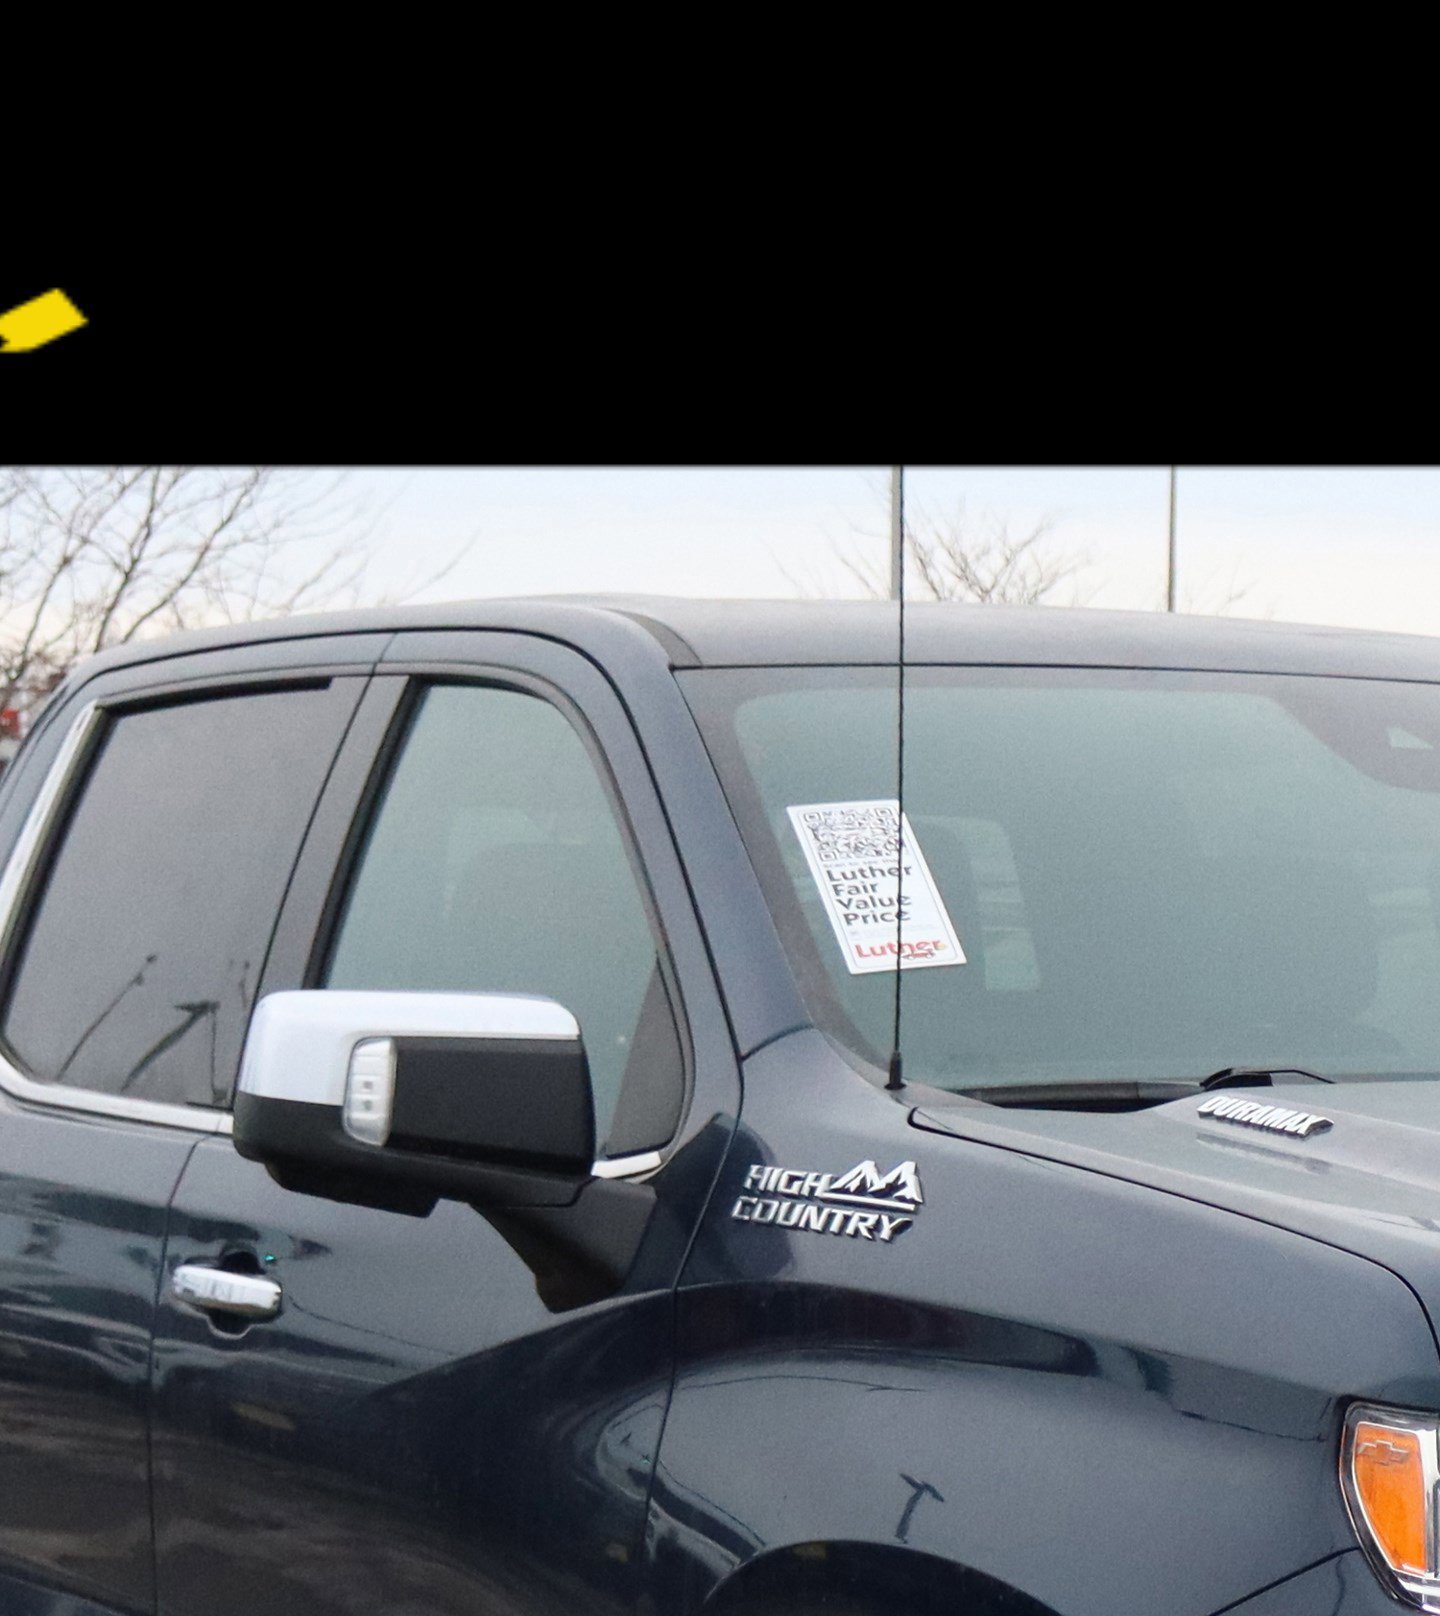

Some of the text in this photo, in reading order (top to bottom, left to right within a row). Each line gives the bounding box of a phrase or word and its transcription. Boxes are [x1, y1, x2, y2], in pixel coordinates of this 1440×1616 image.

[826, 865, 912, 882] Luther
[832, 881, 879, 897] Fair
[836, 894, 911, 911] Value
[843, 910, 911, 926] Price
[1196, 1095, 1335, 1137] DURAMAX
[743, 1164, 836, 1198] HIGH
[731, 1195, 913, 1242] COUNTRY
